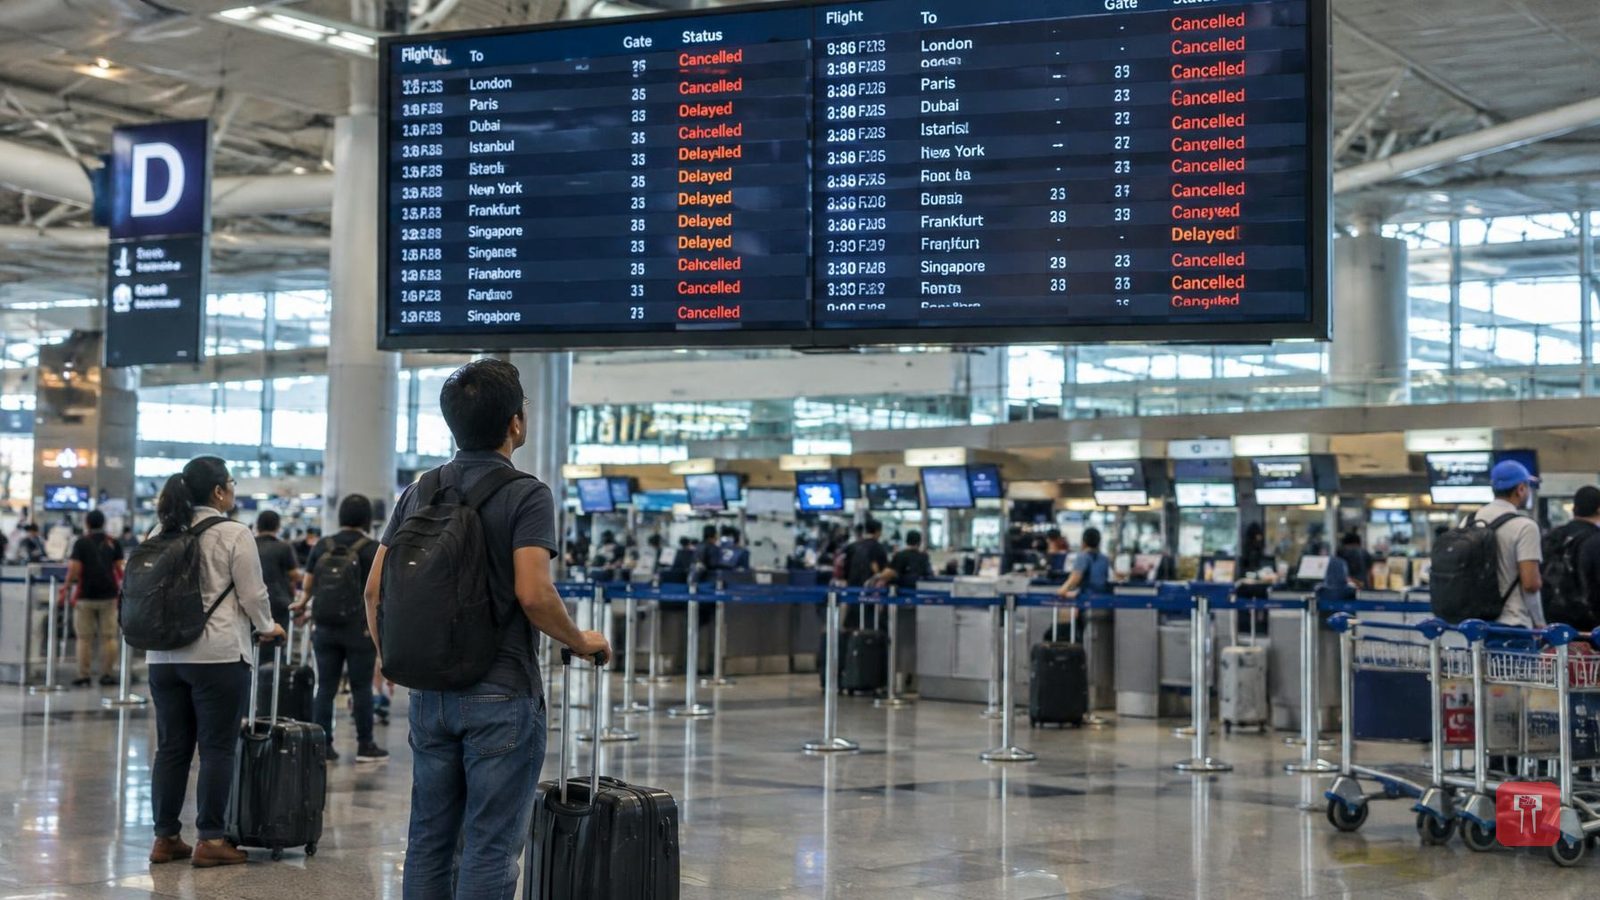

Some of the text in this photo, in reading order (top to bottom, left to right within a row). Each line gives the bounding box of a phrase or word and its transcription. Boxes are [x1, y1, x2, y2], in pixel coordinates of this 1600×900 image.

[1105, 0, 1137, 10] Gate
[827, 10, 863, 25] Flight
[921, 12, 937, 24] To
[1172, 13, 1244, 31] Cancelled
[623, 36, 652, 48] Gate
[683, 30, 722, 43] Status
[922, 39, 972, 51] London
[1172, 37, 1244, 54] Cancelled
[470, 50, 483, 61] To
[680, 49, 742, 66] Cancelled
[1172, 61, 1244, 79] Cancelled
[470, 77, 512, 90] London
[680, 78, 742, 94] Cancelled
[921, 78, 955, 90] Paris
[470, 98, 498, 110] Paris
[1172, 89, 1244, 105] Cancelled
[679, 102, 732, 118] Delayed
[921, 99, 958, 112] Dubai
[470, 120, 500, 132] Dubai
[1172, 114, 1244, 129] Cancelled
[470, 140, 514, 153] Istanbul
[955, 144, 984, 157] York
[1172, 158, 1244, 173] Cancelled
[131, 142, 185, 217] D
[679, 168, 731, 184] Delayed
[498, 182, 522, 194] York
[1172, 182, 1244, 197] Cancelled
[679, 191, 731, 206] Delayed
[469, 203, 520, 216] Frankfurt
[679, 214, 731, 229] Delayed
[921, 214, 983, 228] Frankfurt
[469, 226, 523, 239] Singapore
[679, 235, 731, 251] Delayed
[1172, 252, 1244, 266] Cancelled
[921, 261, 985, 275] Singapore
[678, 281, 740, 294] Cancelled
[1172, 275, 1244, 289] Cancelled
[678, 306, 739, 318] Cancelled
